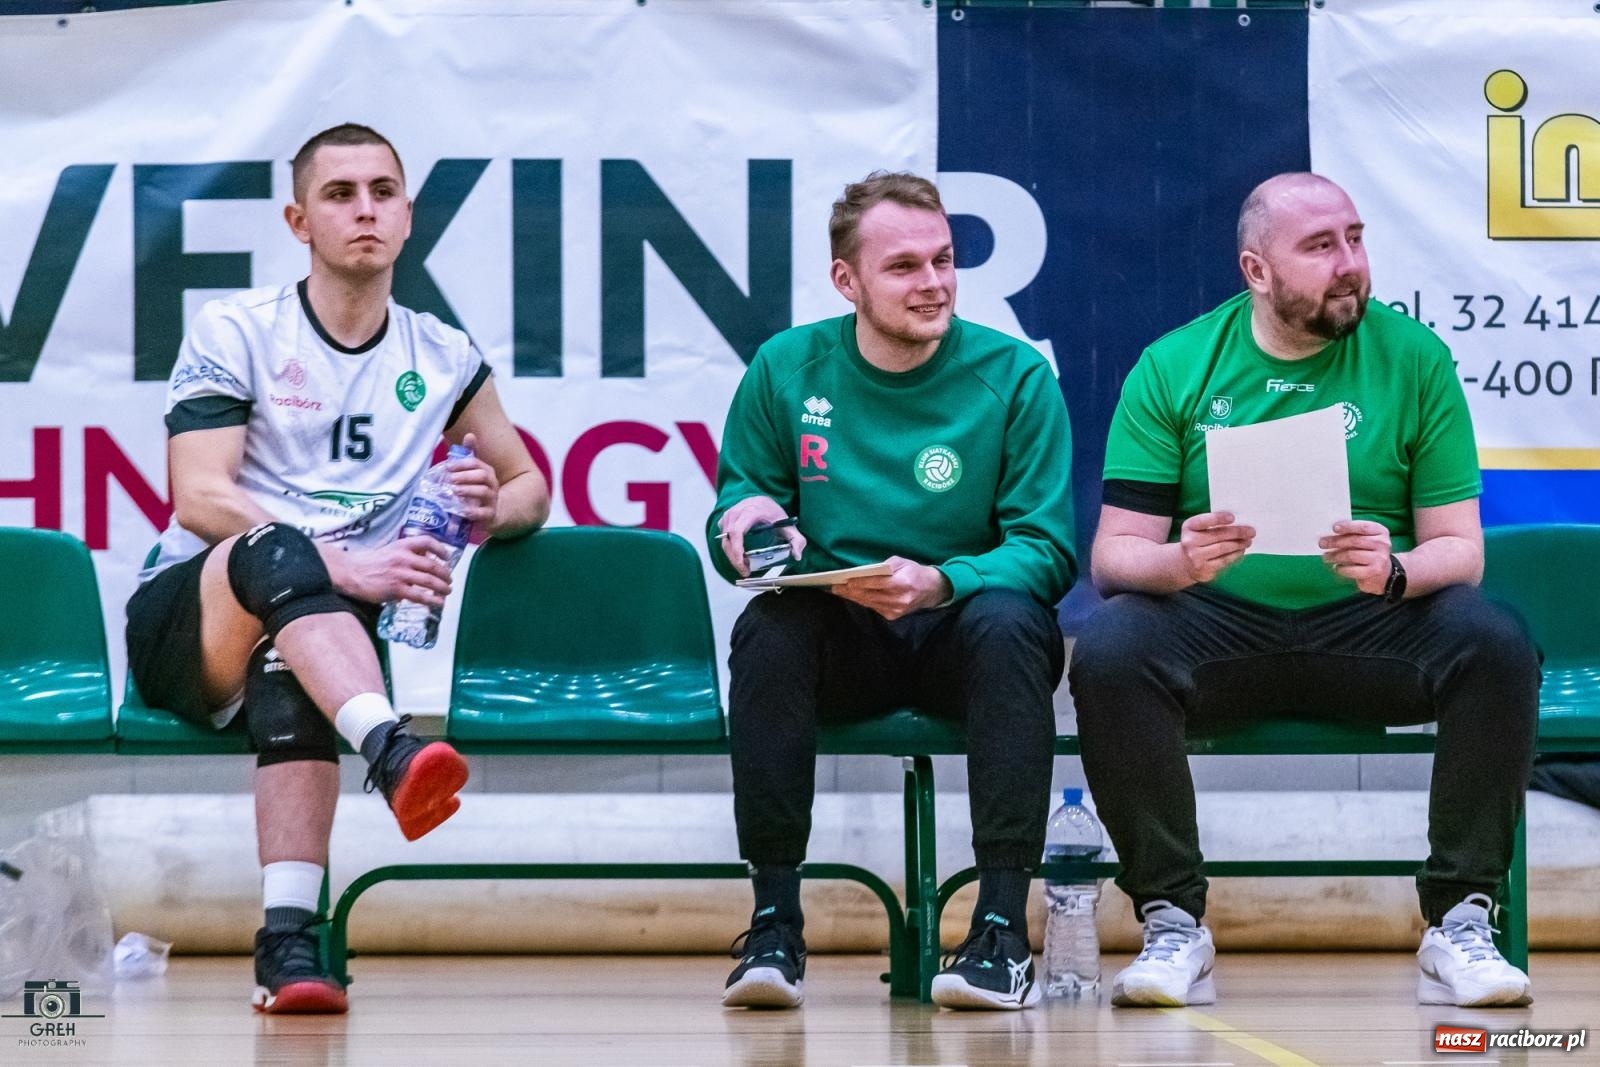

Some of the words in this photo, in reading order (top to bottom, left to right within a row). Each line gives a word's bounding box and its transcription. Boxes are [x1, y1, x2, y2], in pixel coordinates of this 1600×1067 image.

[1452, 295, 1506, 332] 32
[329, 413, 374, 463] 15
[801, 413, 832, 428] errea
